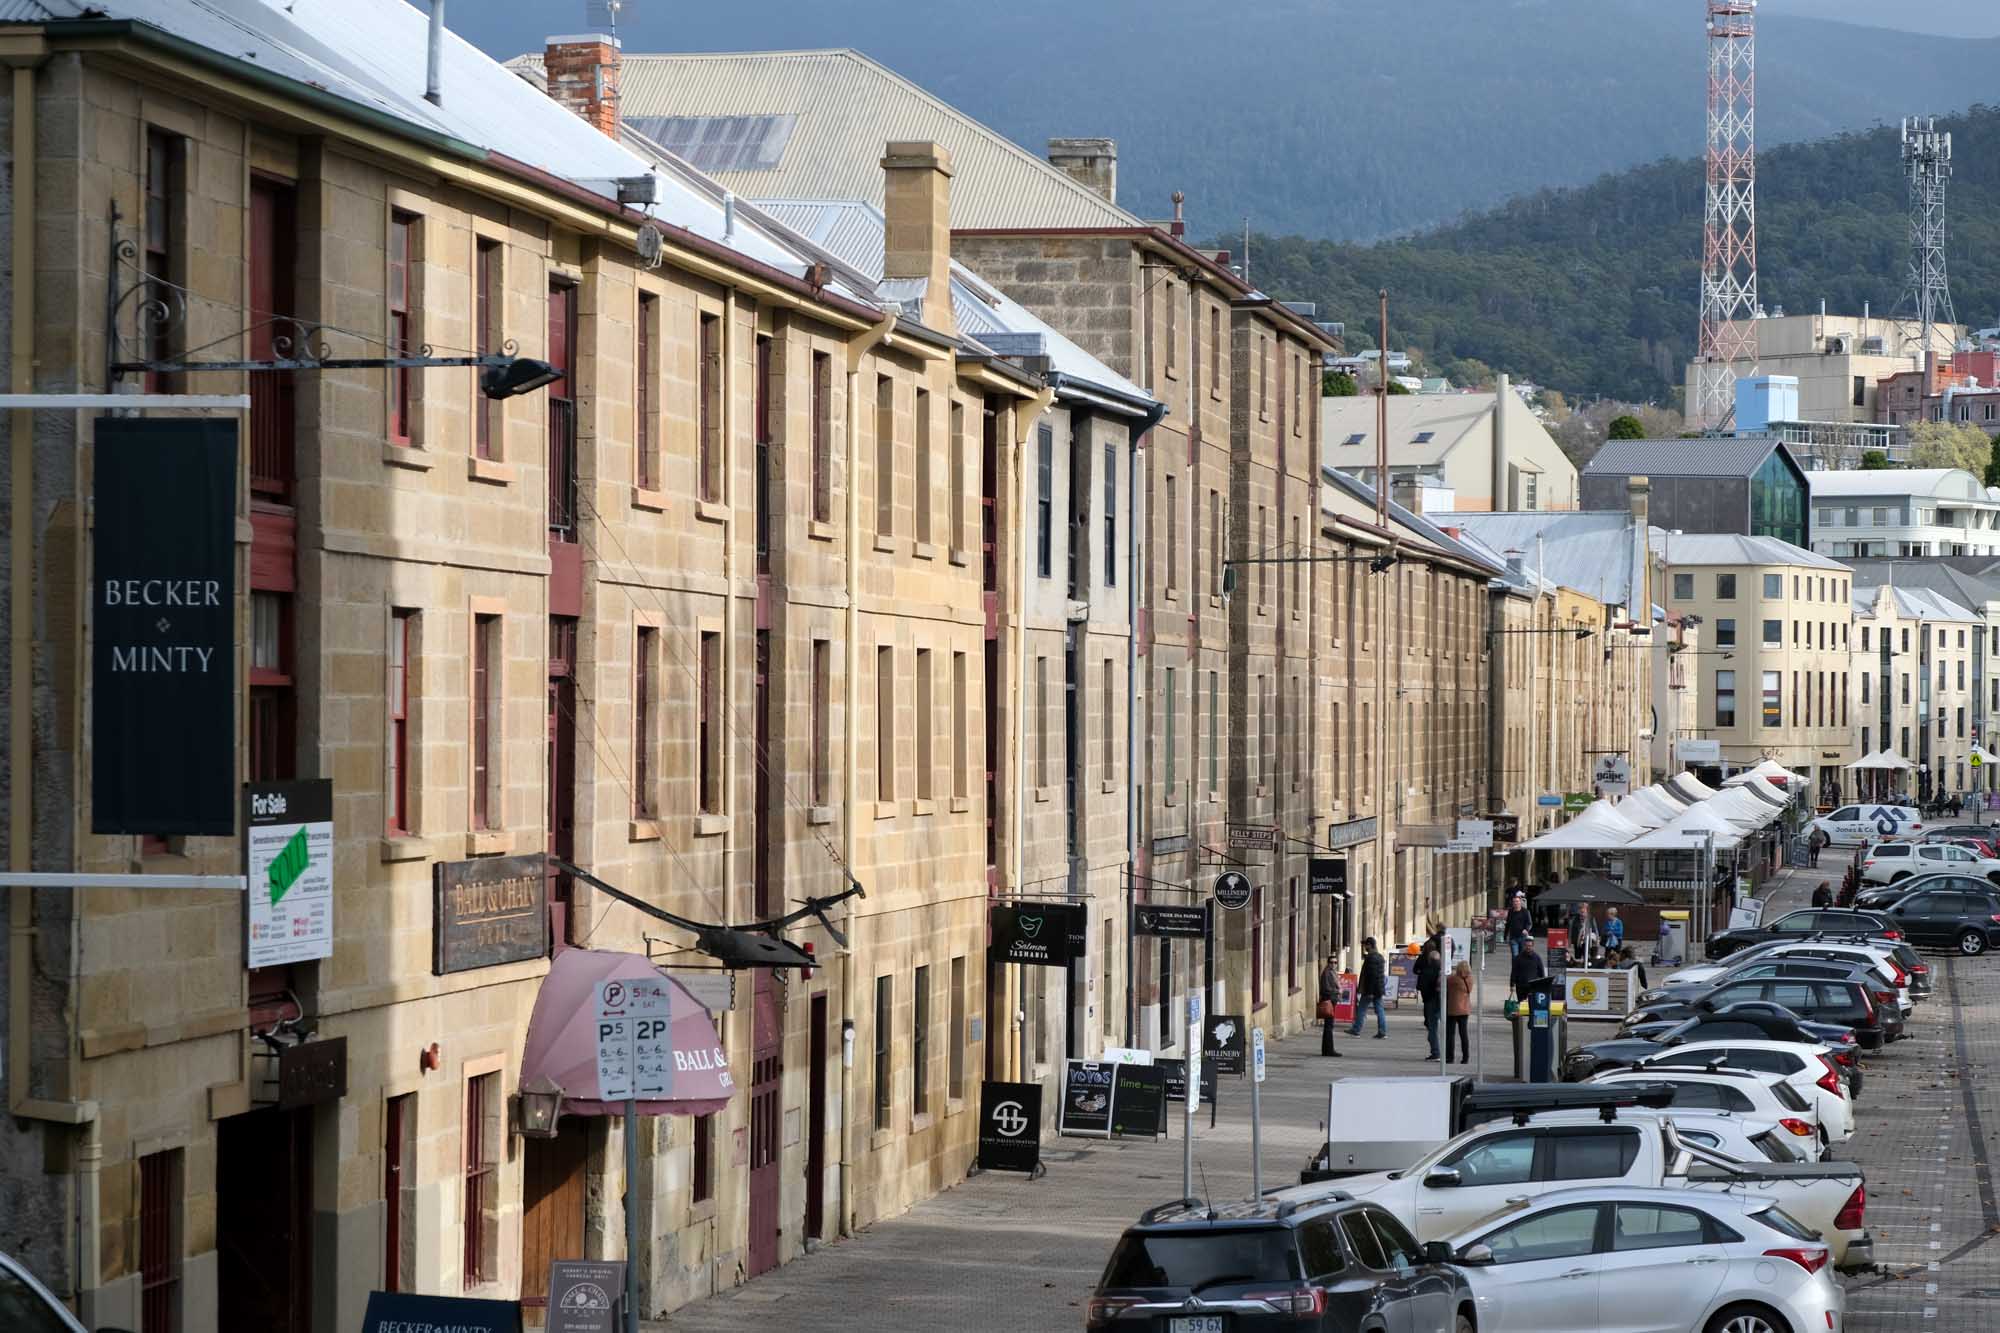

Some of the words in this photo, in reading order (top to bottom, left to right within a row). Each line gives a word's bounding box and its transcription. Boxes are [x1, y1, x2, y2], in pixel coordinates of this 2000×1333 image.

[105, 579, 220, 606] BECKER
[111, 645, 214, 673] MINTY
[252, 793, 268, 815] For
[268, 792, 287, 814] Sale
[1252, 831, 1272, 840] STEPS
[1009, 949, 1049, 959] TASMANIA
[637, 1020, 667, 1040] 2P
[672, 1049, 714, 1071] BALL
[713, 1046, 728, 1068] &
[1204, 1049, 1241, 1058] MILLINERY
[1119, 1077, 1142, 1089] lime
[378, 1319, 434, 1333] BECKER
